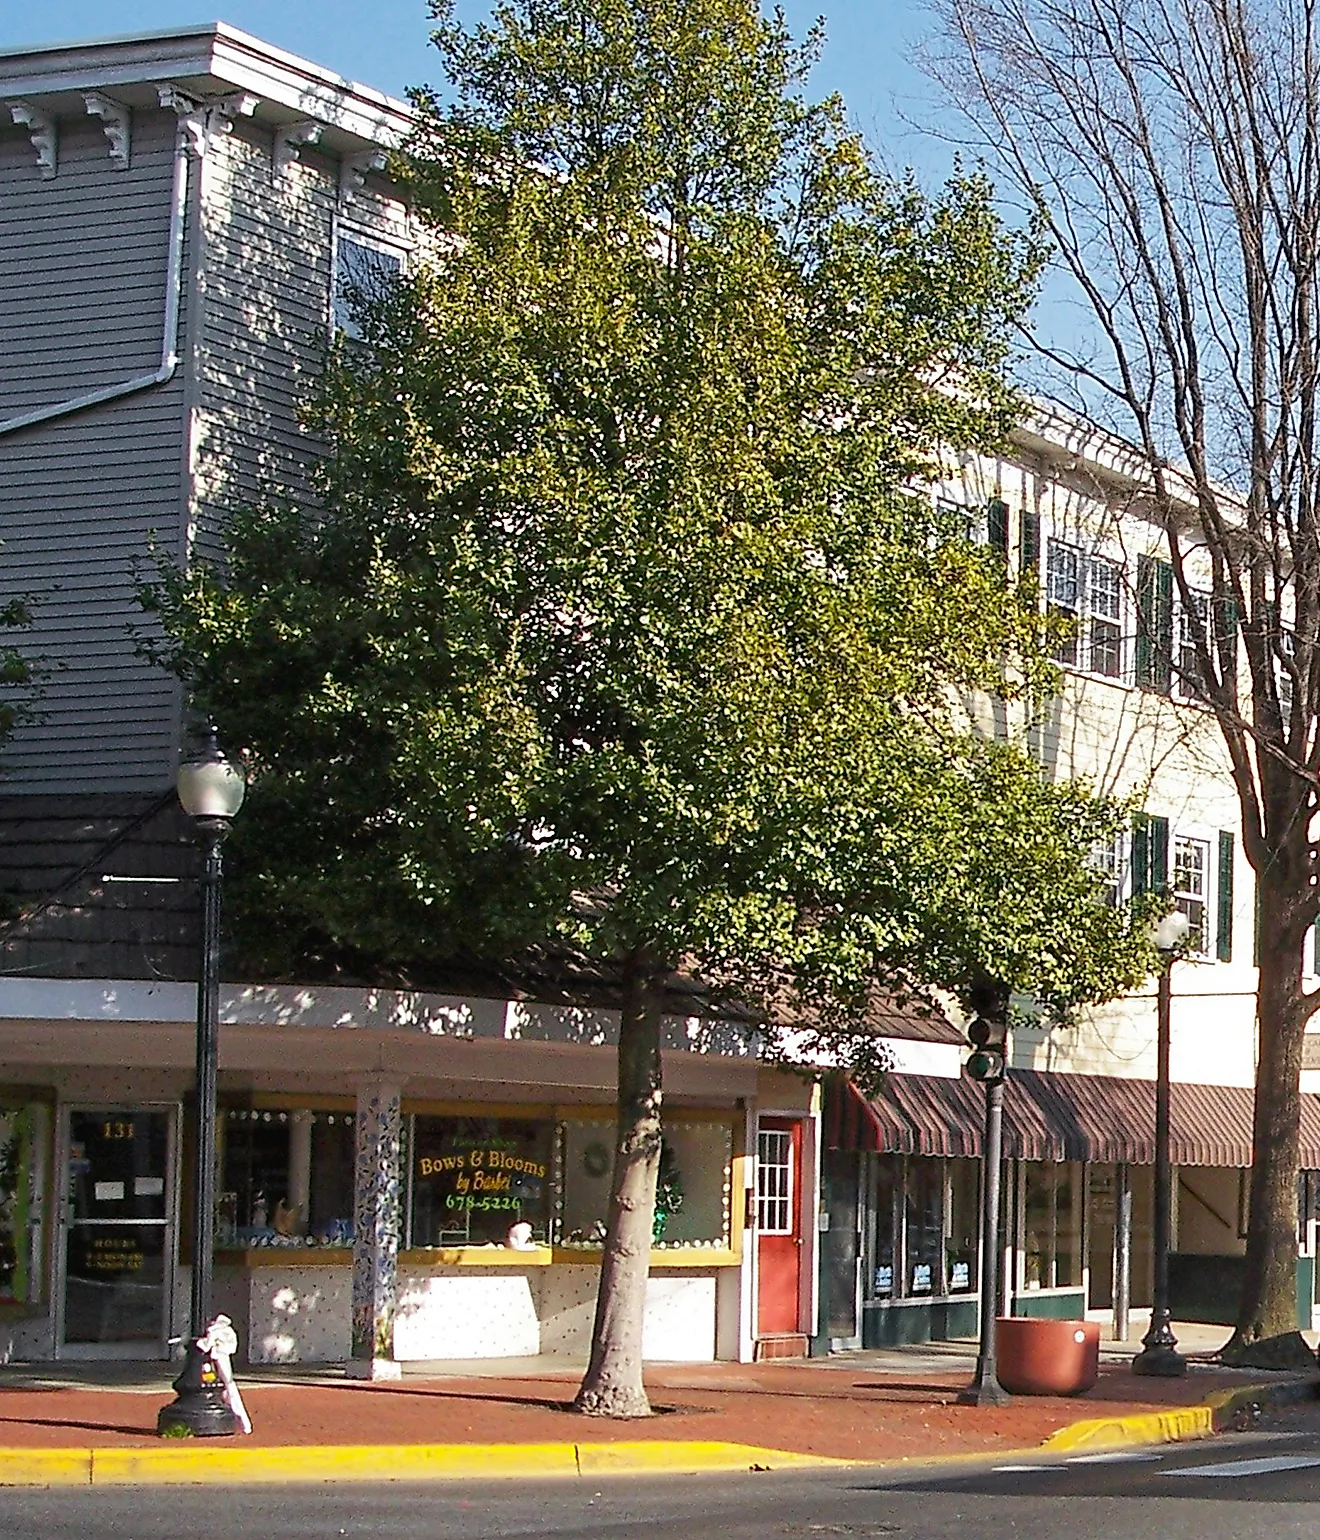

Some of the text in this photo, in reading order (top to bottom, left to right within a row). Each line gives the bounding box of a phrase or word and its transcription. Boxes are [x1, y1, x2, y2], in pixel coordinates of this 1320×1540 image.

[420, 1149, 546, 1178] Bows & Blooms
[456, 1171, 470, 1195] by
